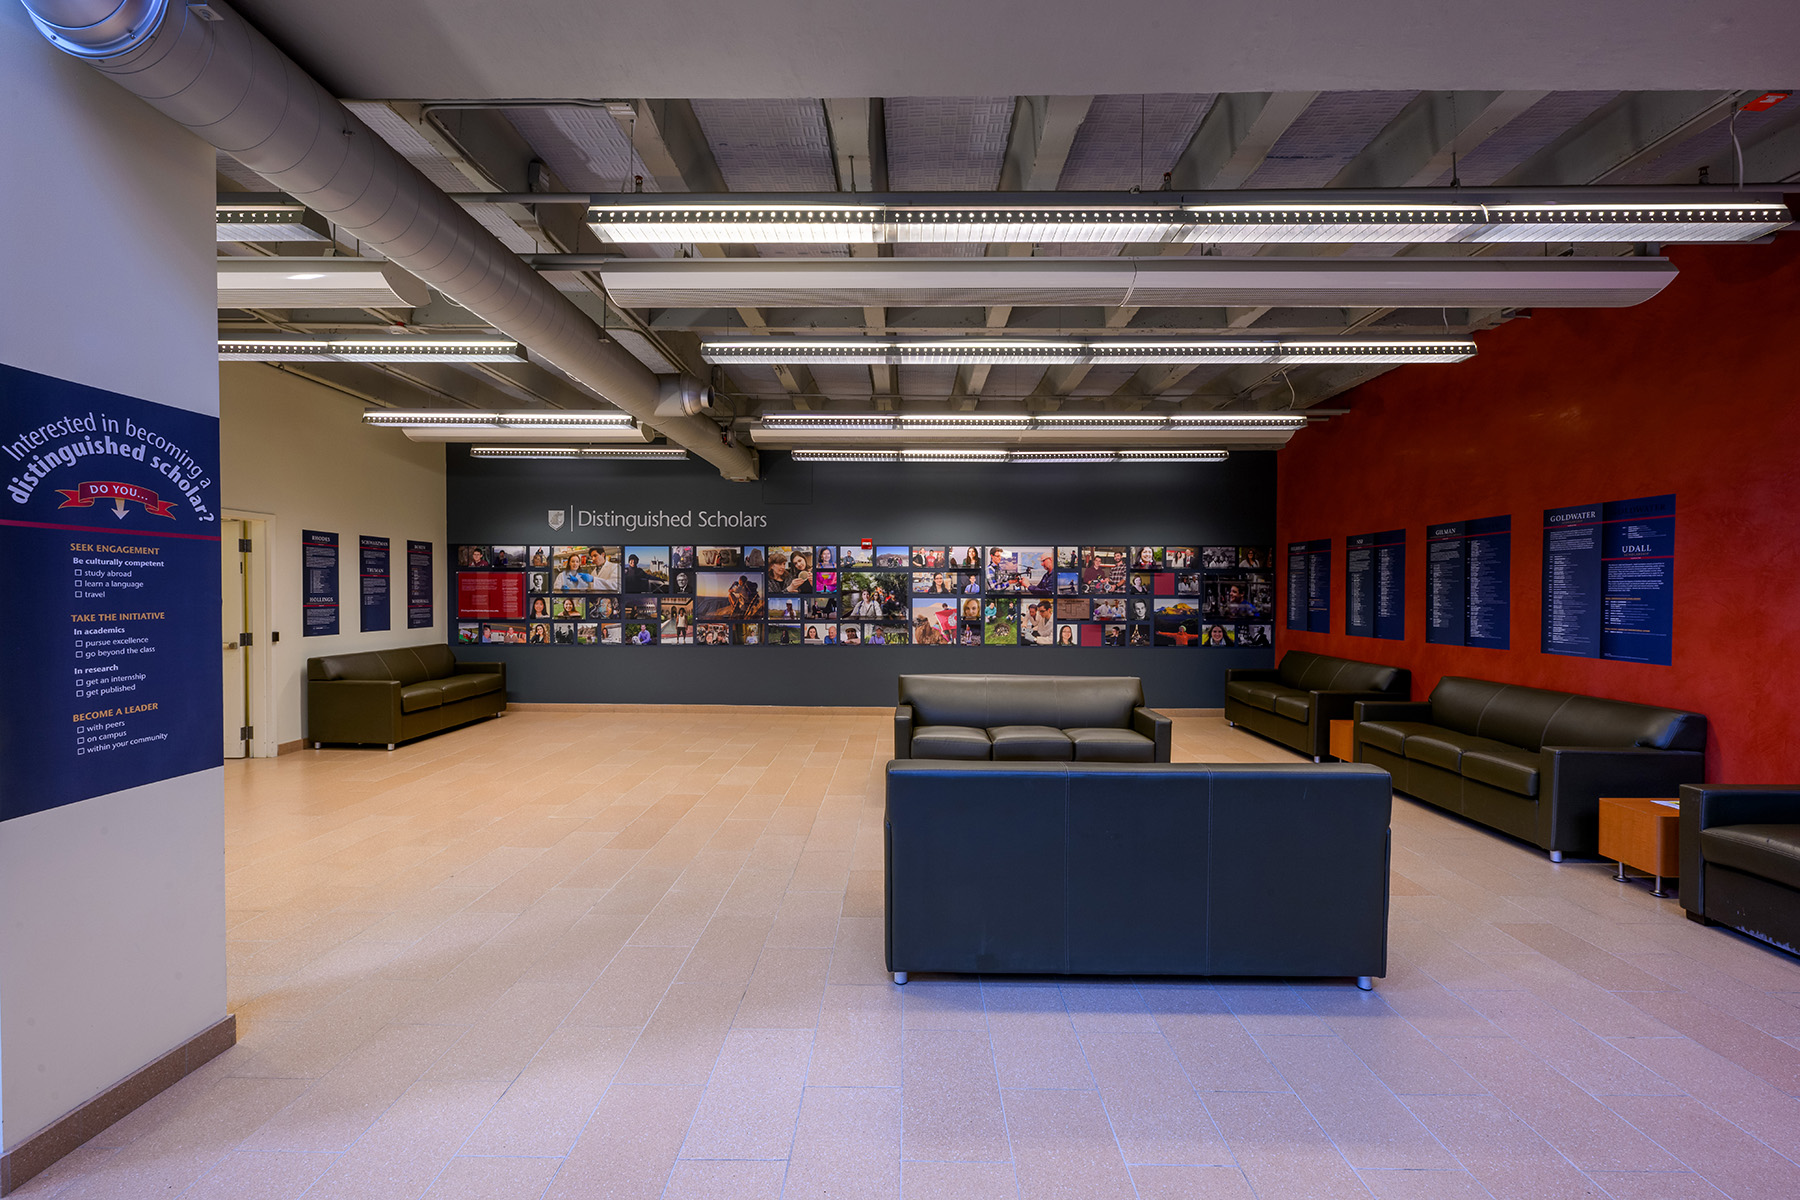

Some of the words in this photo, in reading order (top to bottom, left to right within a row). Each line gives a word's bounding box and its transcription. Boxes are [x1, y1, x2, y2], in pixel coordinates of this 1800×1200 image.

[1, 412, 97, 462] Interested
[101, 413, 119, 434] in
[125, 418, 203, 480] becoming
[199, 477, 212, 489] a
[6, 435, 146, 504] distinguished
[149, 456, 215, 522] scholar?
[89, 484, 109, 494] DO
[112, 485, 149, 501] YOU...
[578, 510, 692, 532] Distinguished
[698, 511, 767, 528] Scholars
[1550, 511, 1596, 522] GOLDWATER
[70, 543, 94, 552] SEEK
[96, 544, 160, 555] ENGAGEMENT
[1621, 545, 1652, 553] UDALL
[85, 558, 123, 567] culturally
[124, 560, 165, 568] competent
[84, 569, 106, 578] study
[111, 580, 144, 589] language
[71, 614, 96, 622] TAKE
[98, 613, 117, 621] THE
[119, 612, 165, 620] INITIATIVE
[84, 626, 126, 635] academics
[85, 639, 112, 648] pursue
[112, 636, 149, 645] excellence
[97, 647, 126, 657] beyond
[84, 663, 119, 674] research
[85, 679, 99, 687] get
[110, 672, 147, 682] internship
[85, 689, 99, 698] get
[100, 684, 136, 695] published
[72, 708, 114, 722] BECOME
[115, 708, 123, 716] A
[124, 702, 159, 714] LEADER
[86, 723, 104, 732] with
[105, 720, 125, 731] peers
[98, 730, 127, 742] campus
[86, 744, 111, 753] within
[111, 740, 129, 750] your
[129, 732, 169, 746] community
